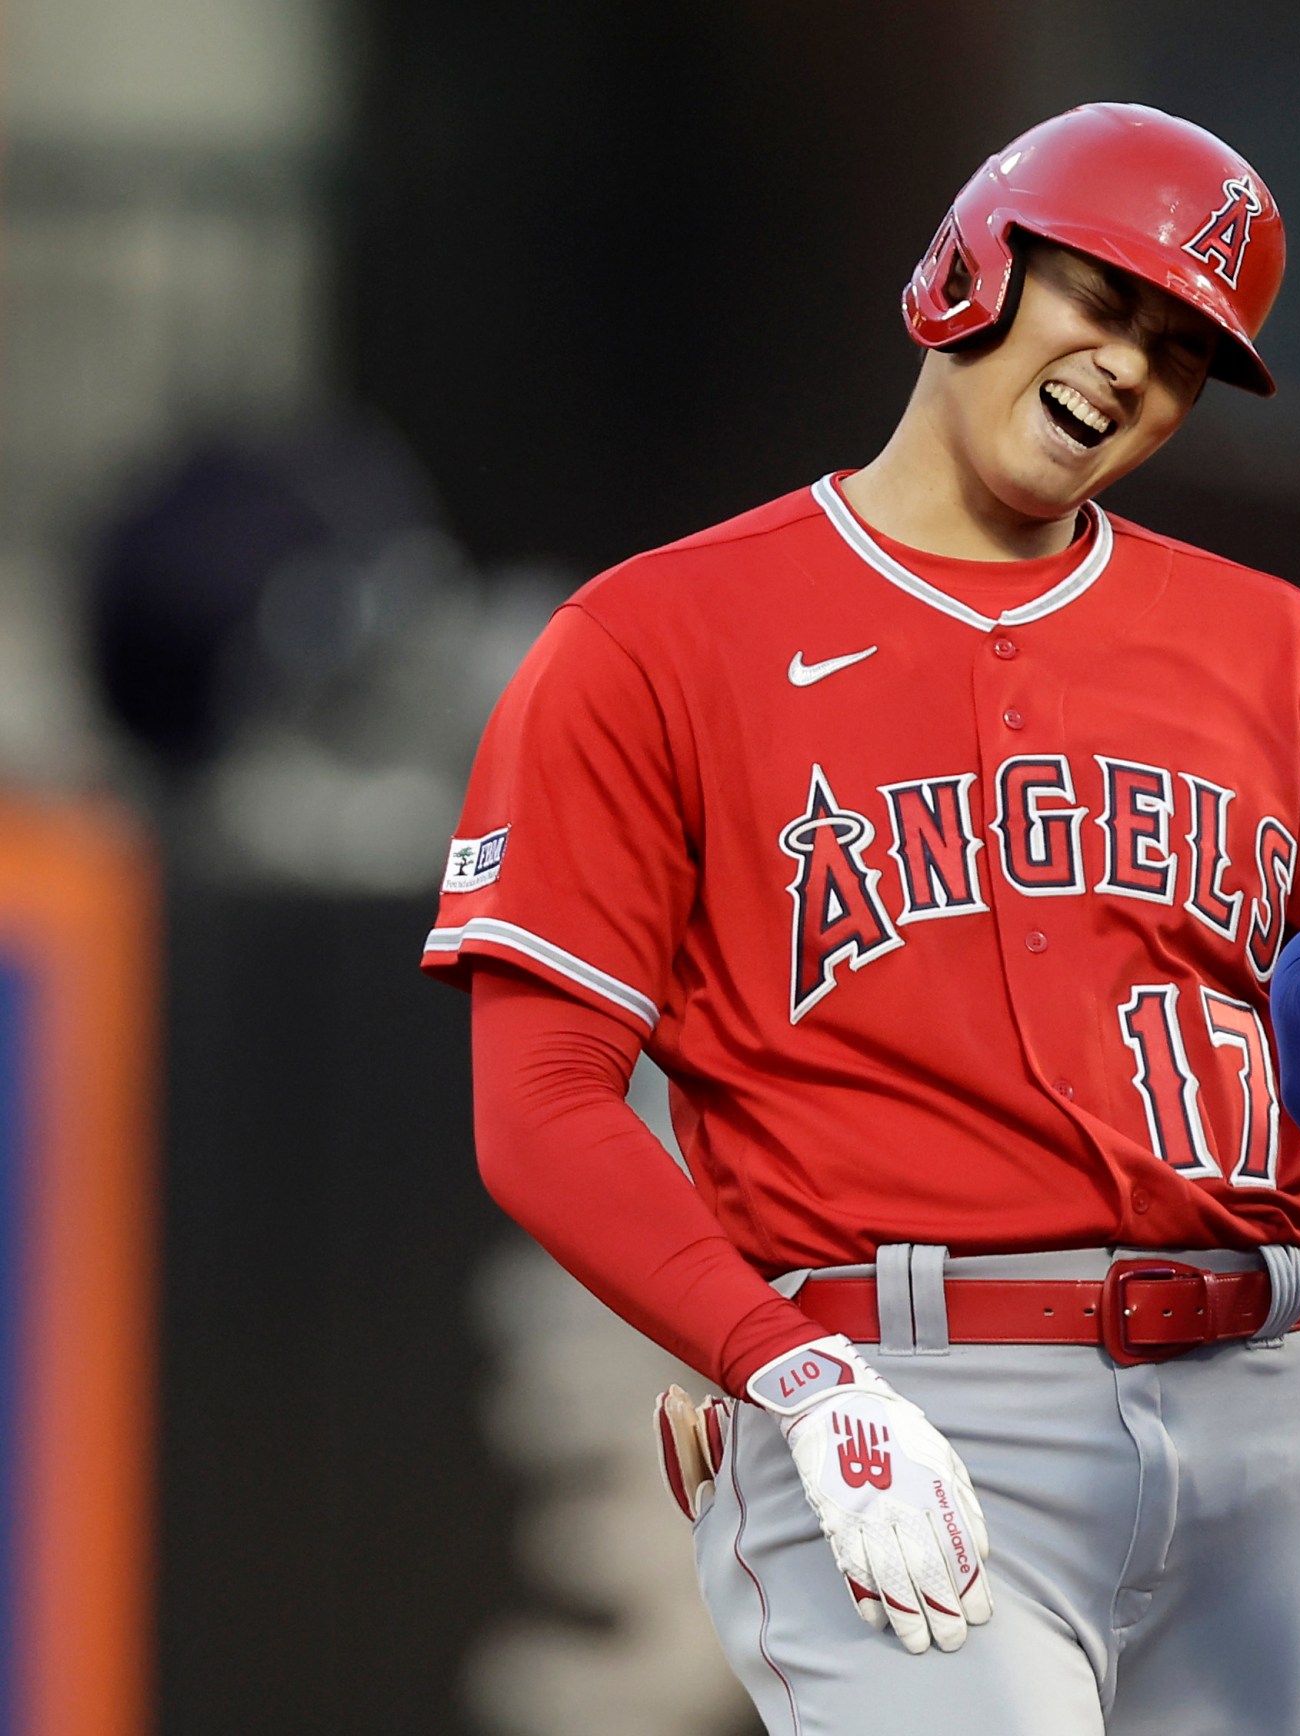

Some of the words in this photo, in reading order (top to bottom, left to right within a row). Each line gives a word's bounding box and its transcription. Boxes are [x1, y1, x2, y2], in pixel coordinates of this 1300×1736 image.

[1181, 174, 1263, 291] A
[779, 753, 1298, 1025] ANGELS
[1117, 983, 1281, 1190] 17
[778, 1360, 821, 1399] 017
[932, 1479, 950, 1509] new
[943, 1511, 971, 1574] balance
